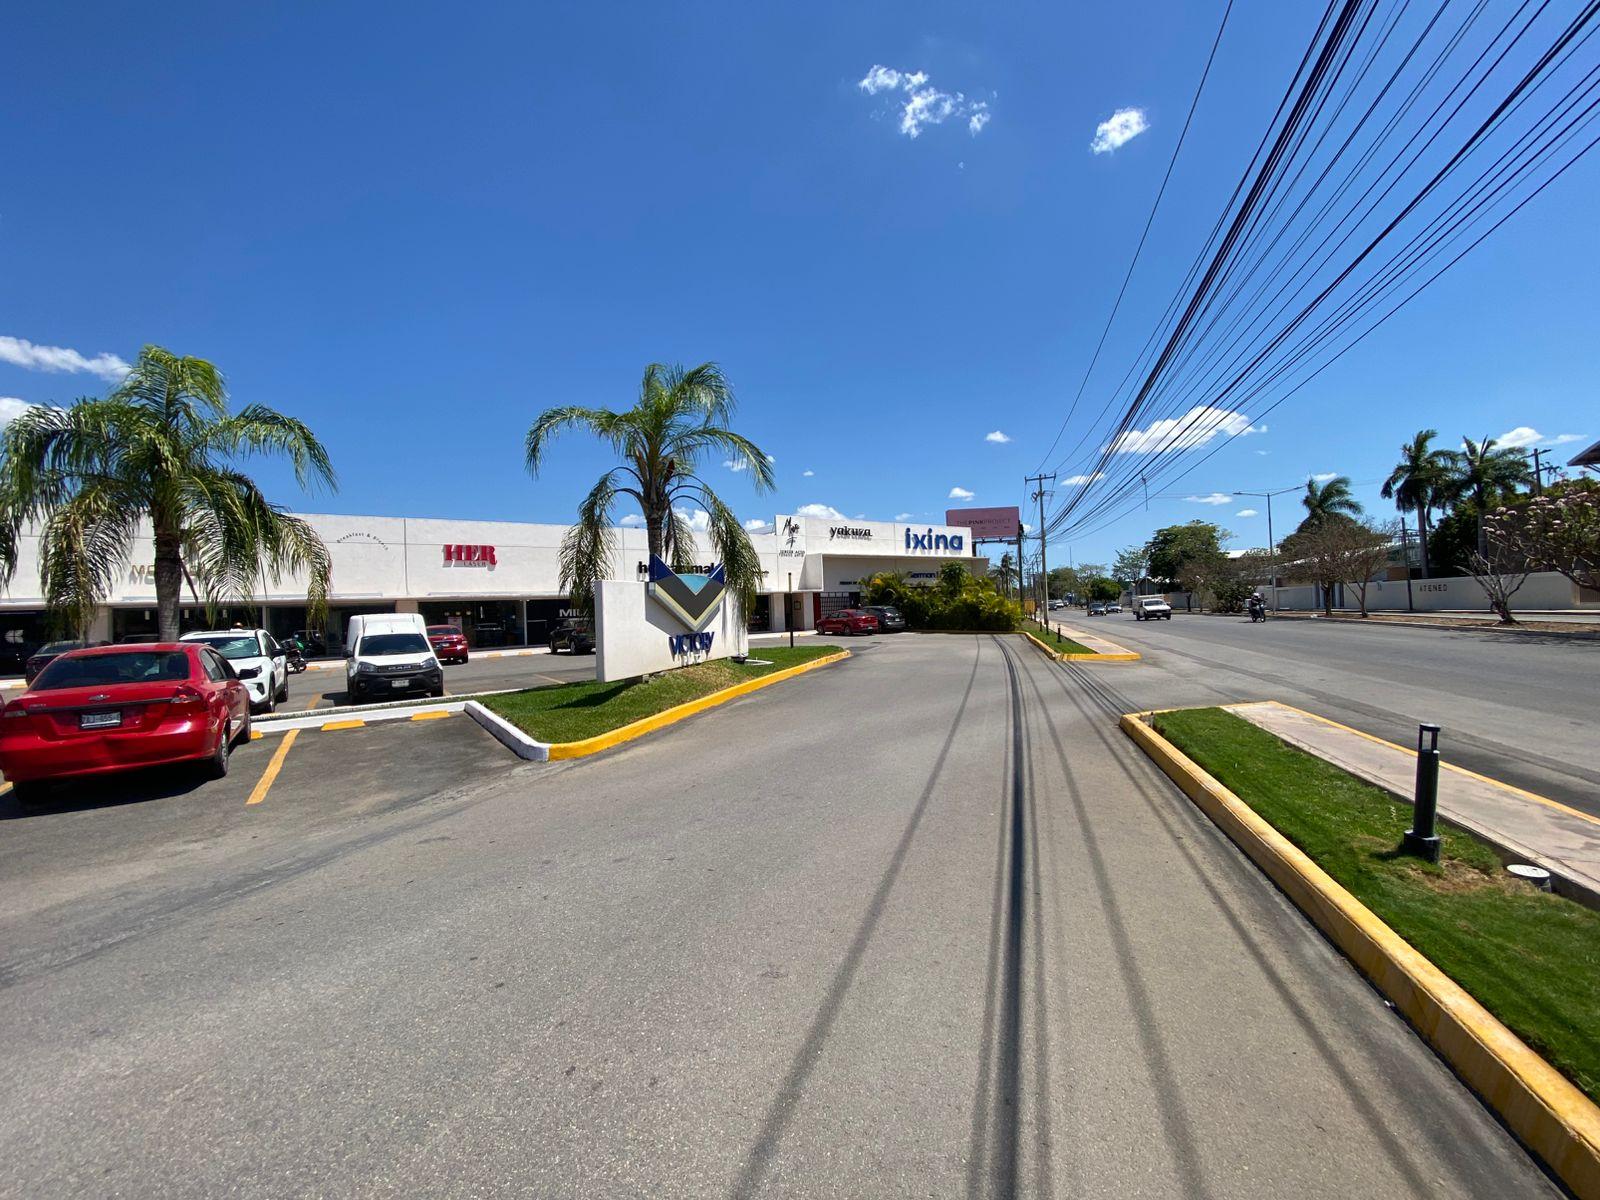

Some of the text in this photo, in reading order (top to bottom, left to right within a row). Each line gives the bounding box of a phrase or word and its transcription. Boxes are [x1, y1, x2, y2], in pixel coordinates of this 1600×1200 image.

[336, 533, 364, 543] Breakfast
[830, 526, 873, 538] yakuza
[905, 528, 963, 550] ixina
[443, 545, 497, 565] HER
[669, 631, 715, 656] VICTORY
